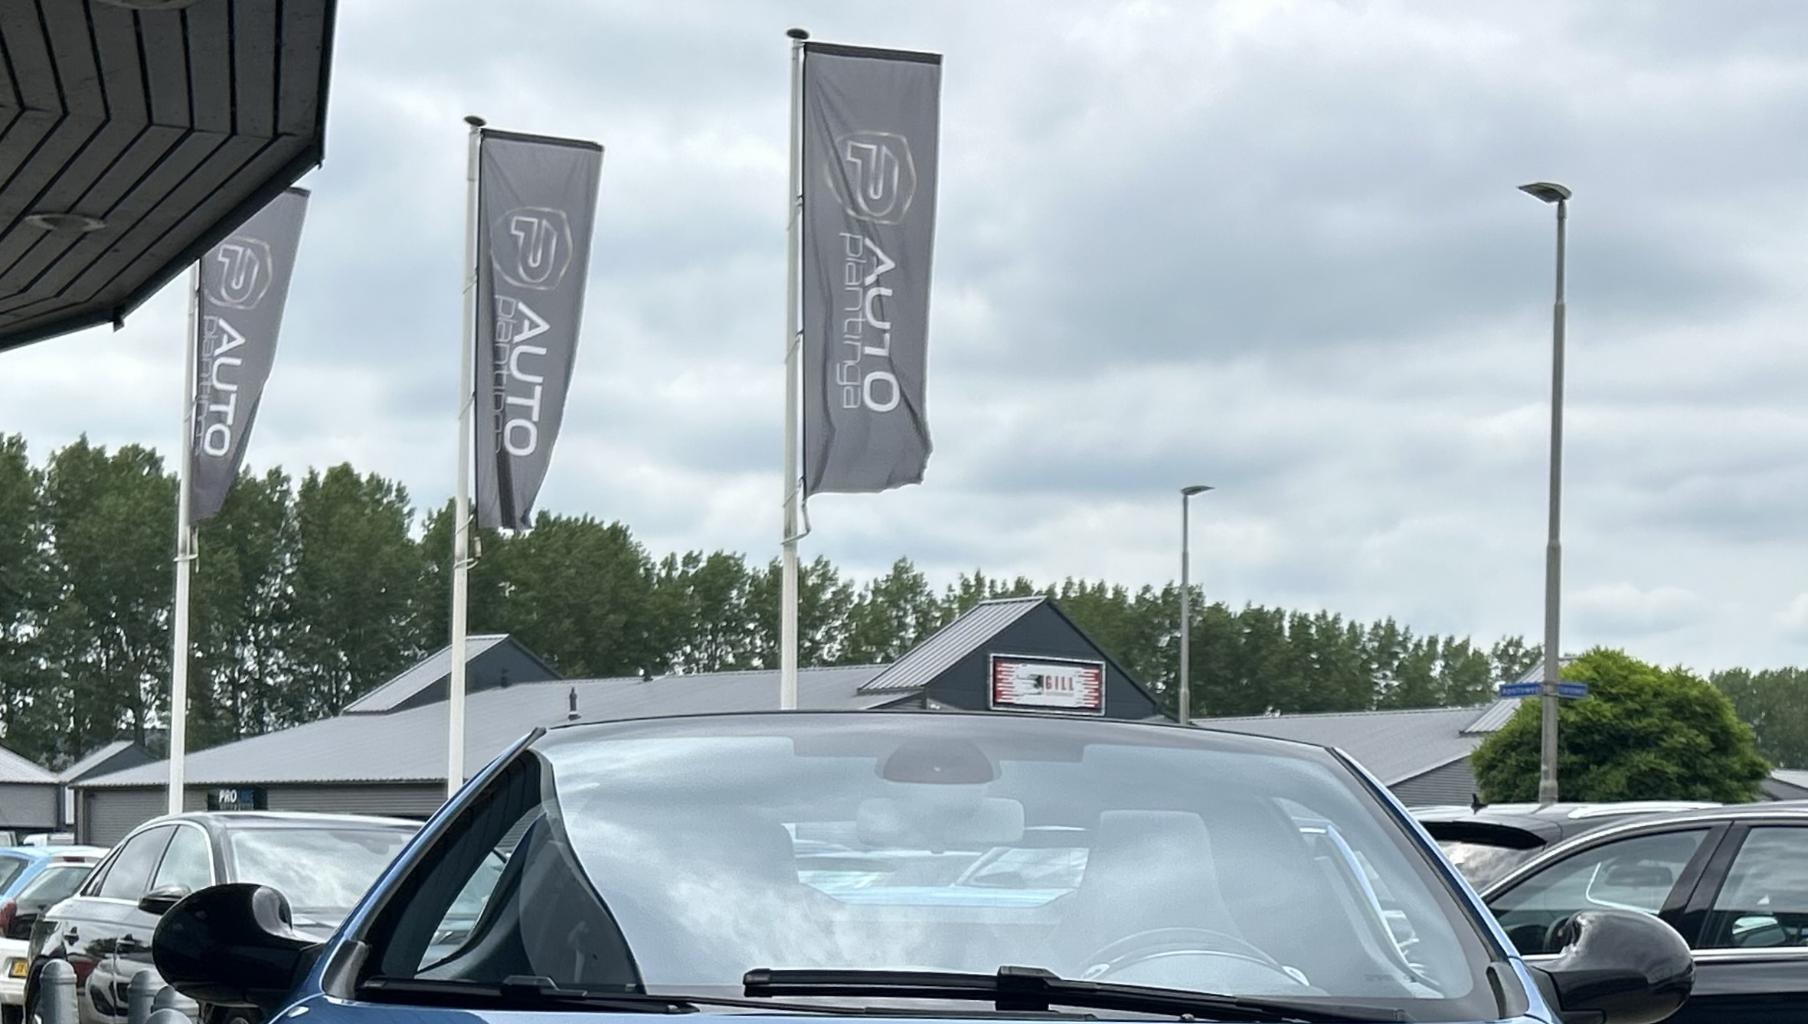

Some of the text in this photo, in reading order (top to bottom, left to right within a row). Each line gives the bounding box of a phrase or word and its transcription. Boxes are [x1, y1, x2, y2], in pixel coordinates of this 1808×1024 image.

[203, 318, 246, 457] AUTO
[503, 301, 551, 457] AUTO
[836, 232, 866, 409] plantinga
[862, 237, 901, 413] AUTO
